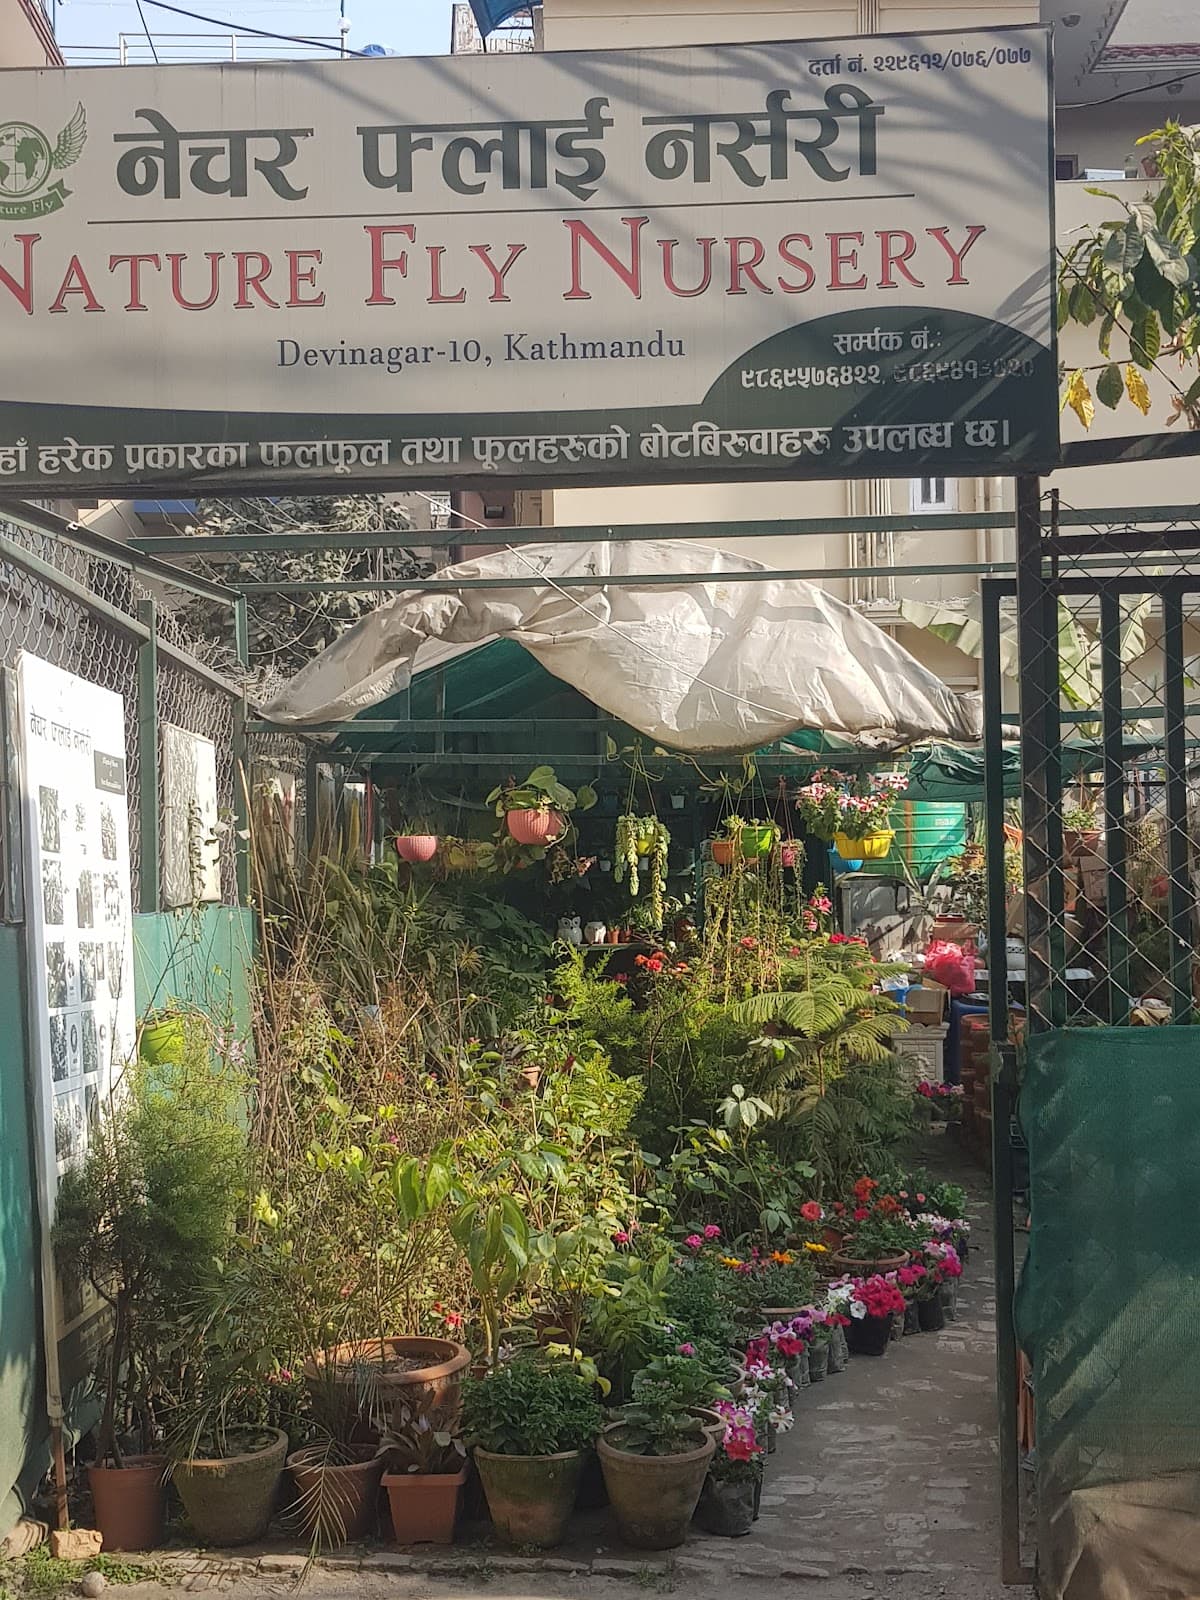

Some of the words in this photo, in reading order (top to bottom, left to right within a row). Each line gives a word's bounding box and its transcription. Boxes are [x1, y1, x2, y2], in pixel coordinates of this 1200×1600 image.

[808, 54, 841, 77] दर्ता
[847, 53, 868, 73] नं.
[873, 47, 1032, 72] २२९६१२/०७६/०७७
[113, 108, 314, 201] नेचर
[356, 97, 614, 202] फ्लाई
[642, 83, 885, 188] नर्सरी
[31, 199, 54, 214] Fly
[363, 223, 528, 306] FLY
[562, 216, 986, 300] NURSERY
[276, 337, 493, 374] Devinagar-10,
[503, 330, 686, 361] Kathmandu
[38, 437, 115, 475] हरेक
[124, 441, 249, 474] प्रकारका
[258, 439, 392, 474] फलफूल
[401, 437, 463, 464] तथा
[842, 422, 954, 453] उपलब्ध
